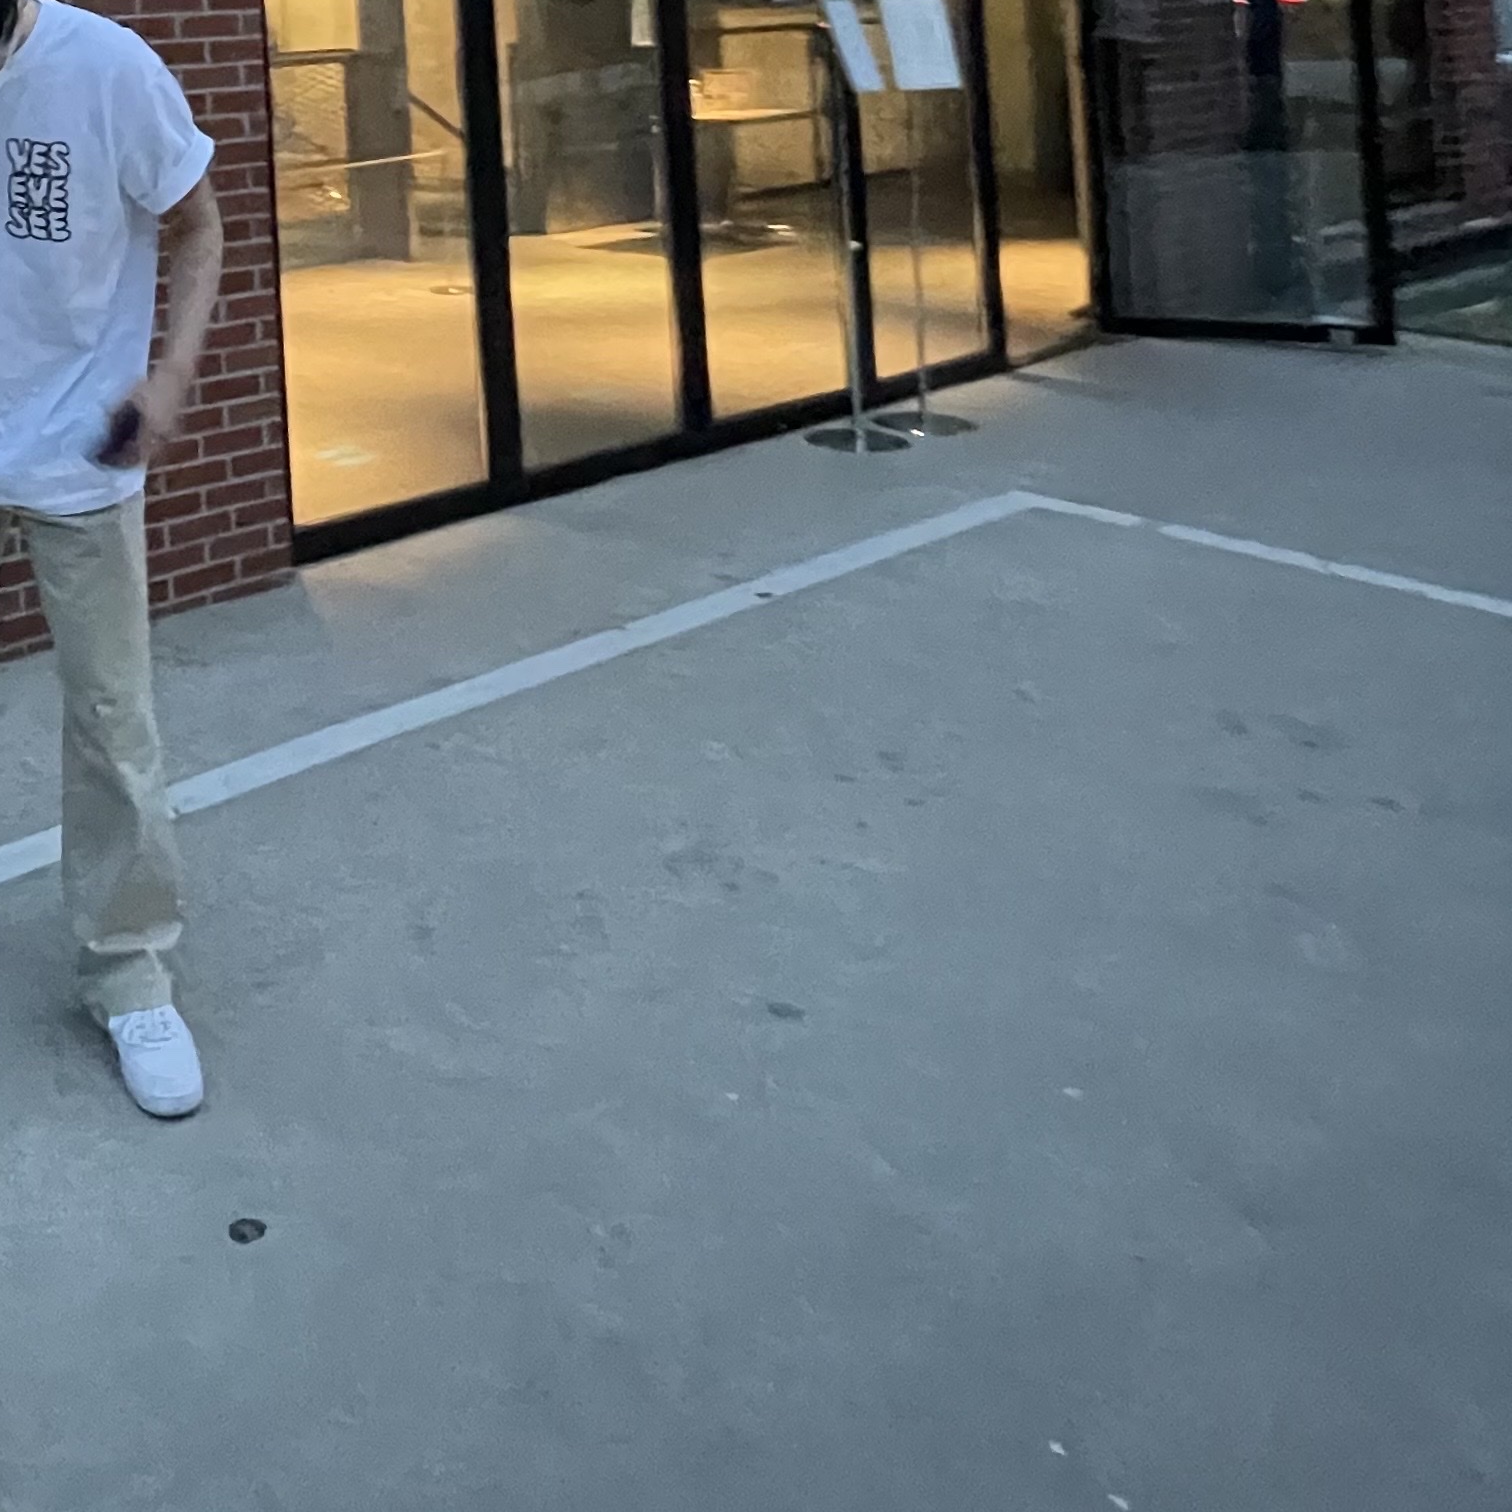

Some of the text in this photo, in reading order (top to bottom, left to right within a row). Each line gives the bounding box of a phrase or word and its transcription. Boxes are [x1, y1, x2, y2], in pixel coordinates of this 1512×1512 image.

[6, 138, 71, 178] YES
[7, 173, 68, 211] EYE
[5, 204, 72, 242] SEE
